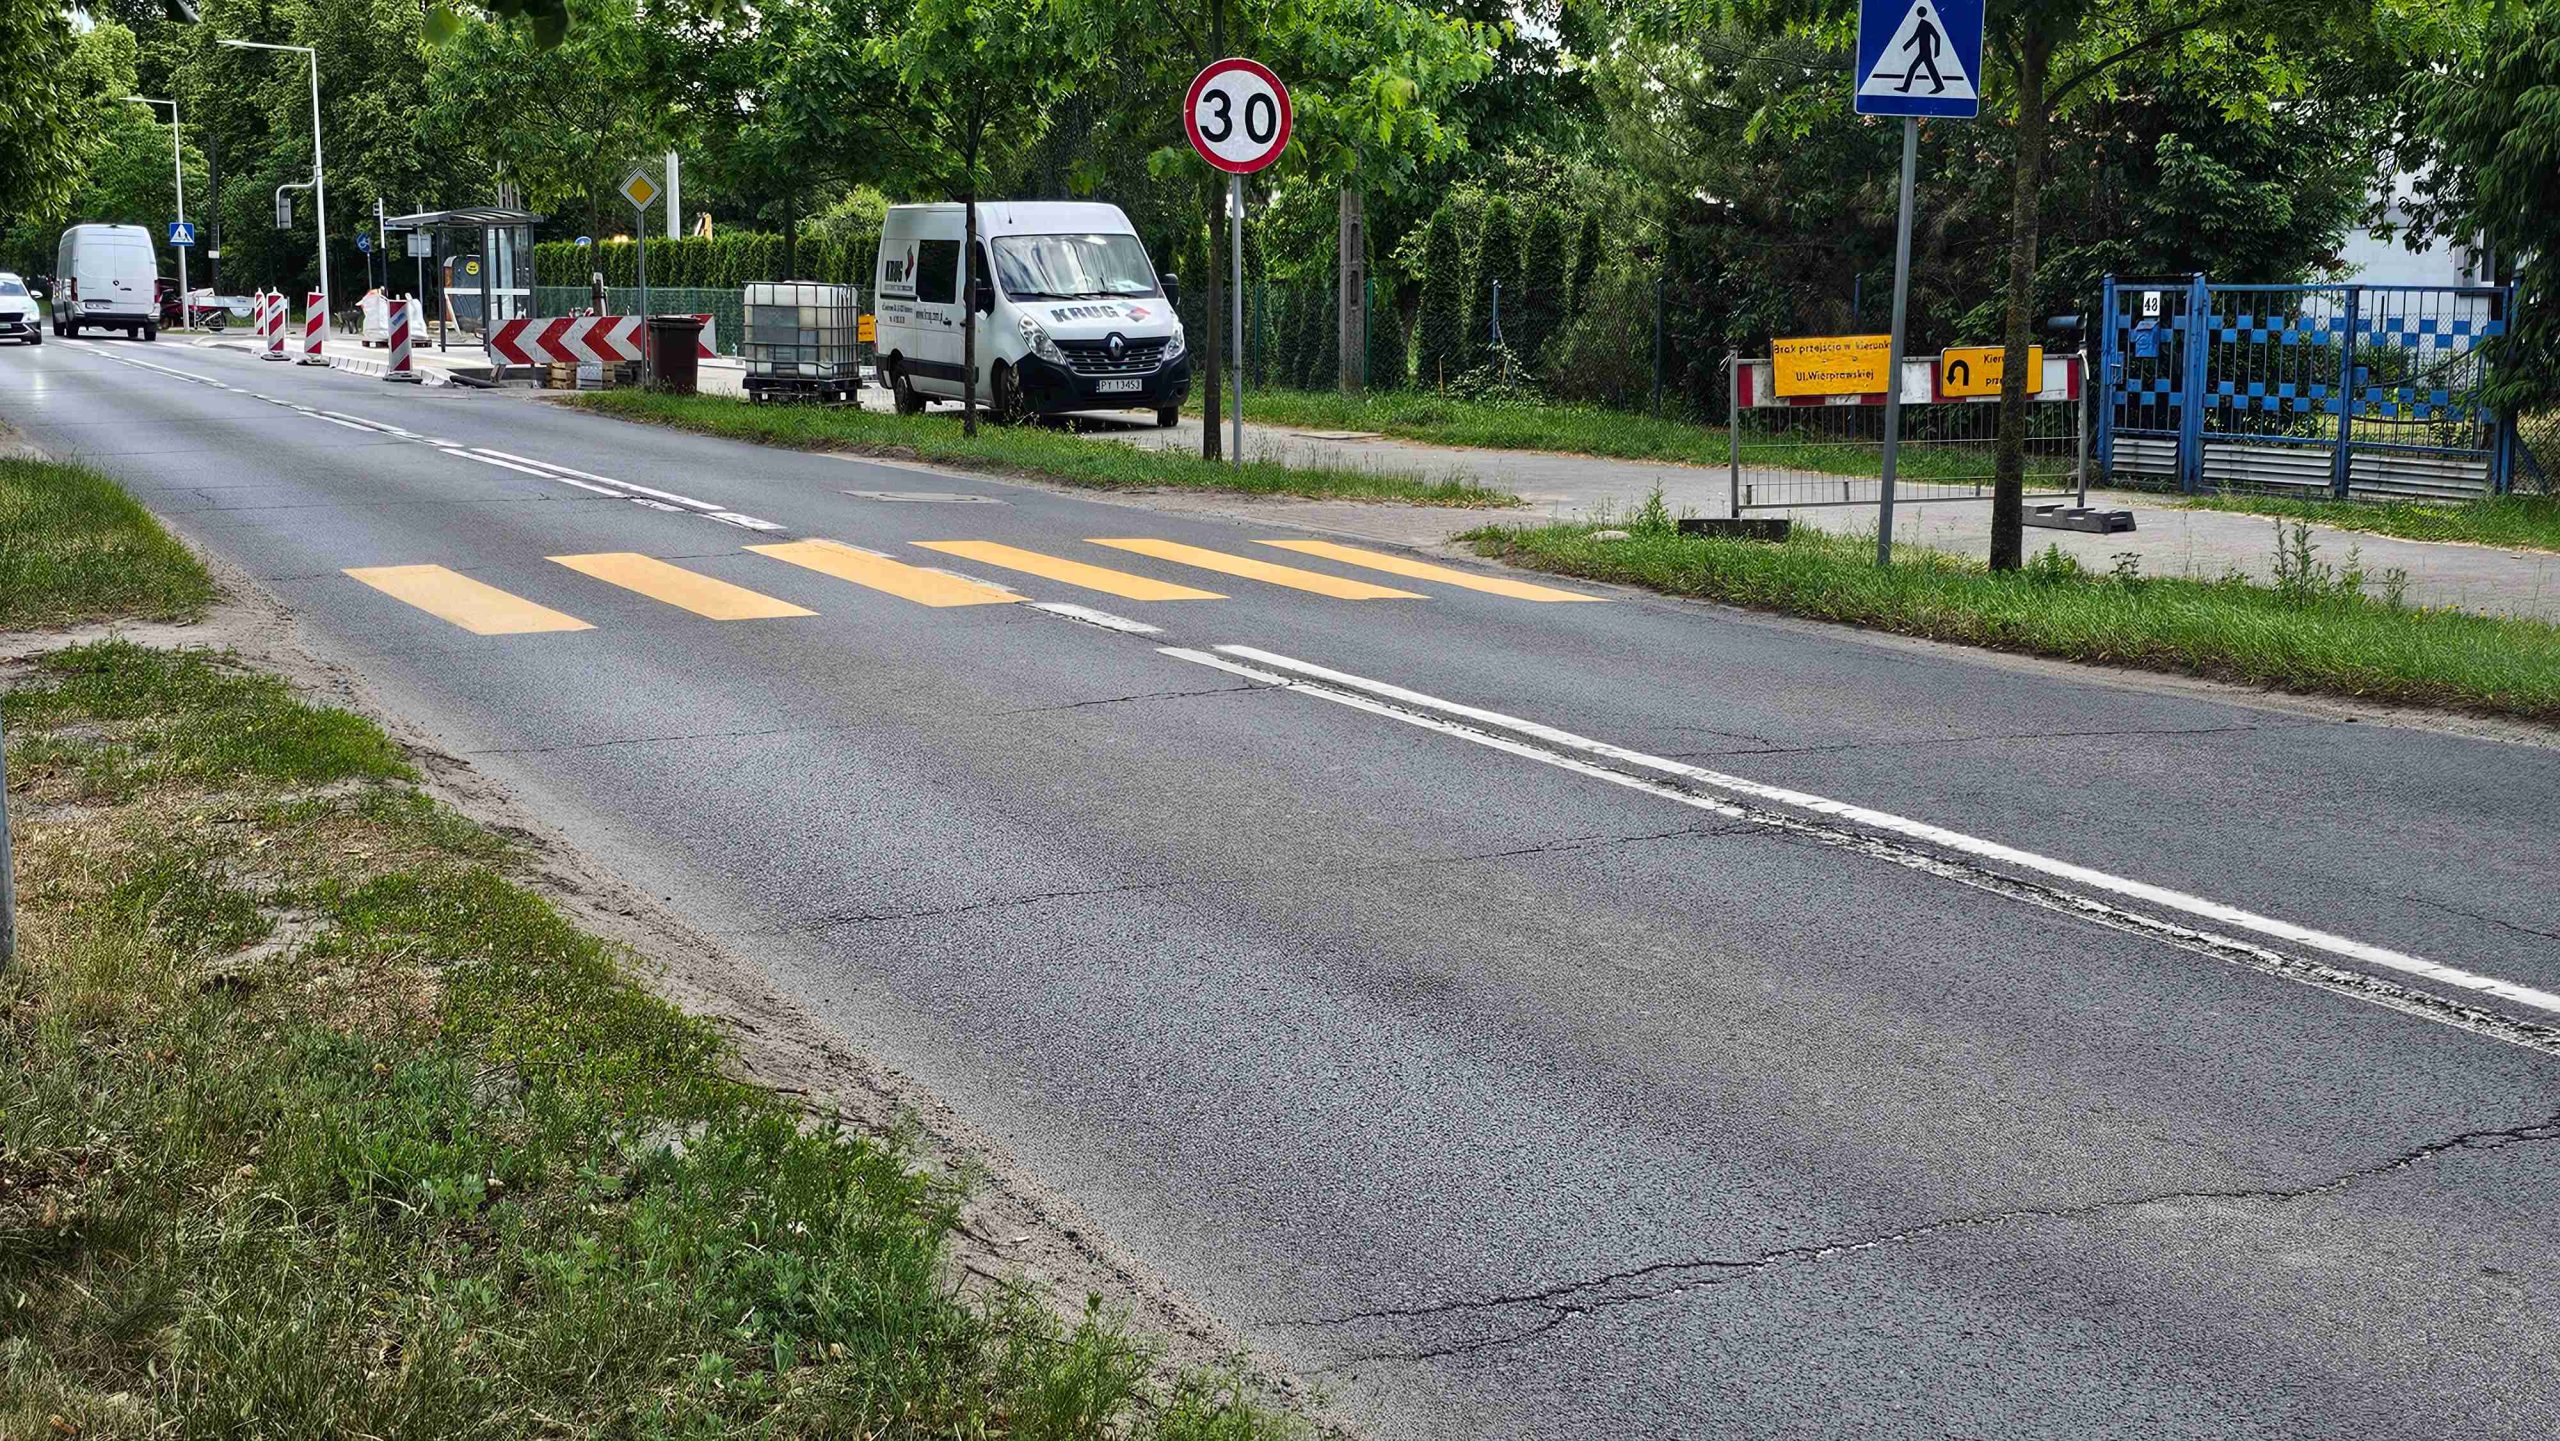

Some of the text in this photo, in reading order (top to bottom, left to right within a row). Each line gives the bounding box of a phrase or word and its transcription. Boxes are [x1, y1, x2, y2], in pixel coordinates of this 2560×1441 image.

[1200, 88, 1277, 145] 30
[1050, 305, 1120, 323] KRUG
[1774, 344, 1796, 354] Brak
[1855, 339, 1889, 350] kierunk
[1101, 380, 1112, 390] PY
